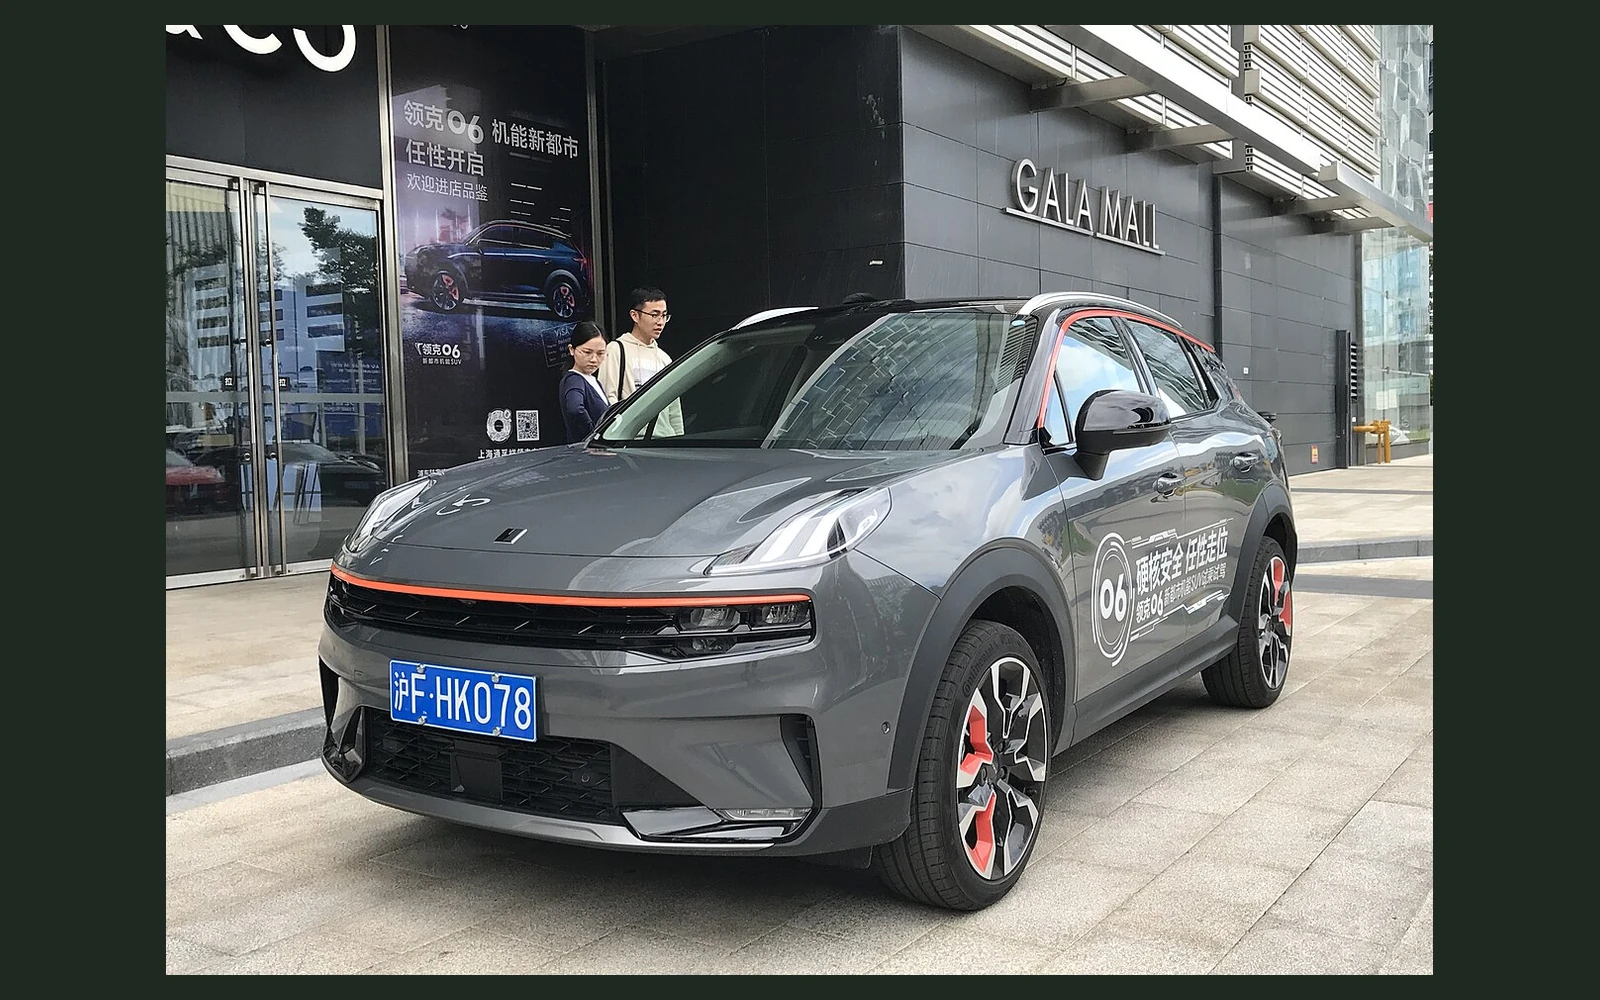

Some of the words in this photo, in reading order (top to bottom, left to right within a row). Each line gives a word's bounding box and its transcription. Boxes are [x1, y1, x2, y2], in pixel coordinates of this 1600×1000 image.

[404, 99, 484, 144] 领克06
[491, 118, 579, 159] 机能新都市
[405, 138, 484, 177] 任性开启
[407, 172, 489, 202] 欢迎进店品鉴
[1011, 158, 1093, 231] GALA
[1101, 186, 1159, 249] MALL
[1135, 543, 1184, 596] 硬核安全
[1185, 526, 1229, 575] 任性走位
[1100, 573, 1127, 622] 06
